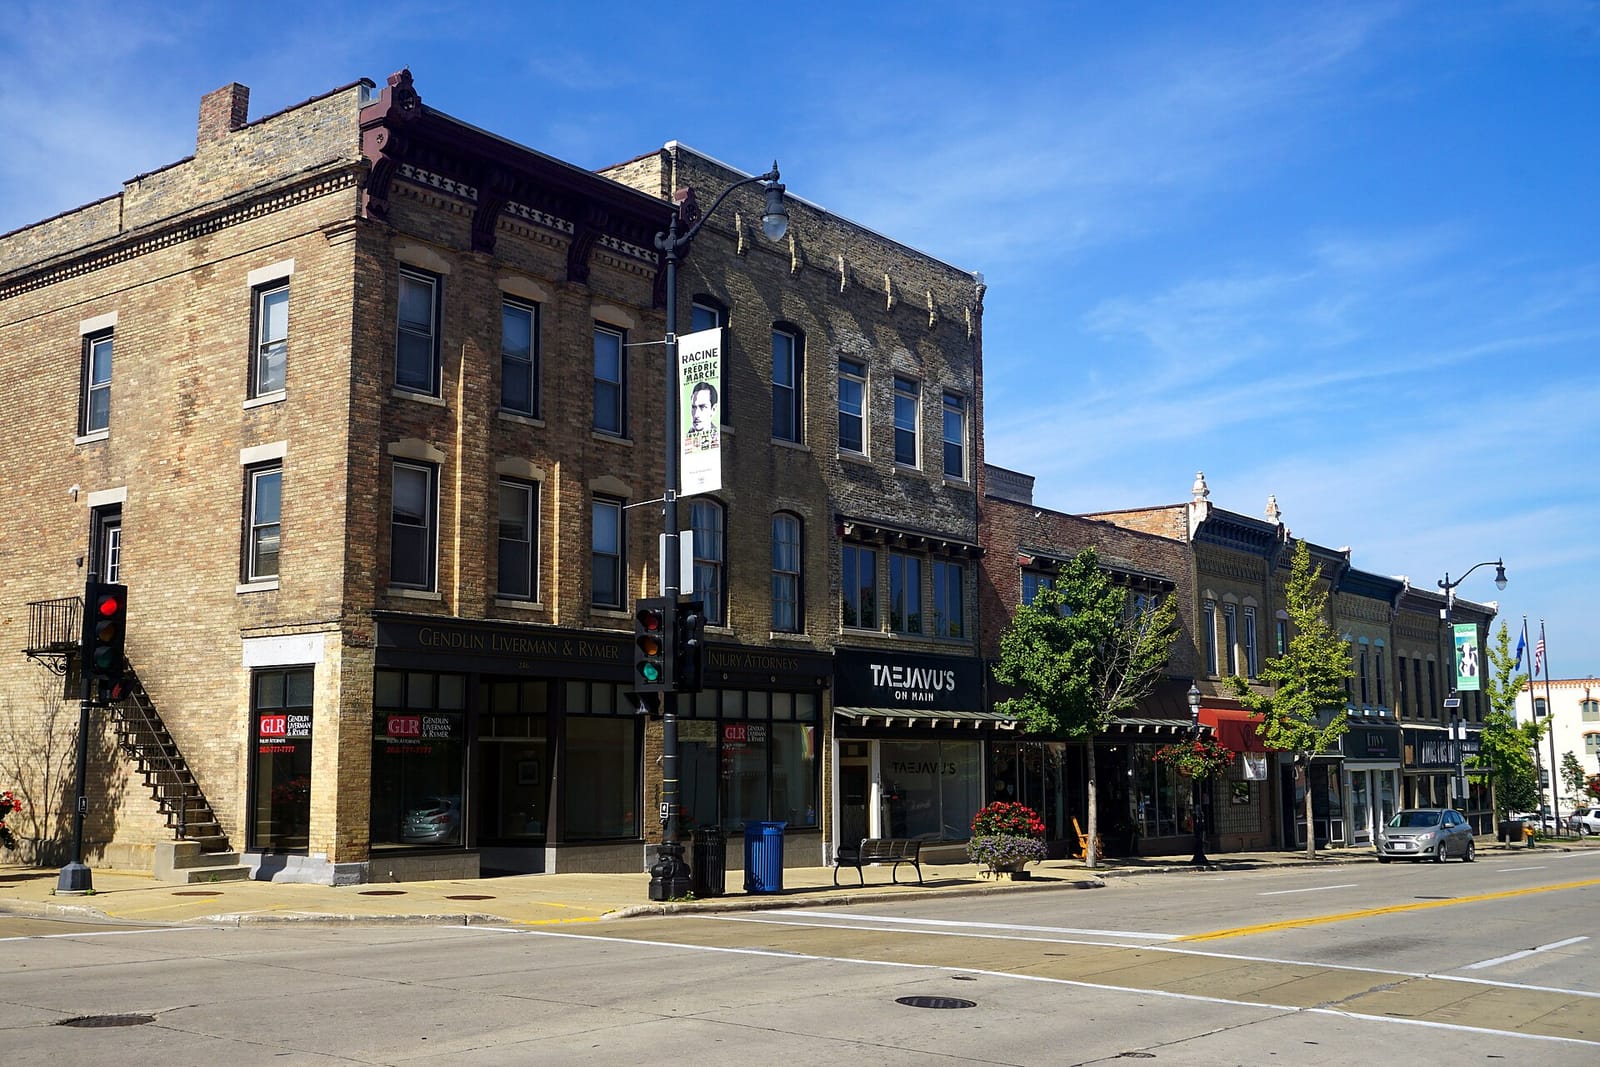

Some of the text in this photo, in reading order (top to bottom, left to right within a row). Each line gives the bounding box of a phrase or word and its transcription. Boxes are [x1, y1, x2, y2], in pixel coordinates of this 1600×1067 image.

[682, 347, 719, 364] RACINE
[683, 361, 718, 376] FREDRIC
[686, 369, 716, 382] MARCH
[418, 627, 619, 659] GENDLIN LIVERMAN & RYMER
[707, 649, 799, 670] INJURY ATTORNEYS
[870, 664, 955, 691] TAEJAVU'S
[894, 690, 934, 702] ON MAIN
[287, 714, 310, 723] GENDLIN
[422, 716, 449, 724] GENDLIN
[261, 718, 286, 734] GLR
[388, 719, 420, 734] GLR
[422, 723, 451, 731] LIVERMAN
[725, 727, 746, 739] GLR
[429, 730, 449, 738] RYMER
